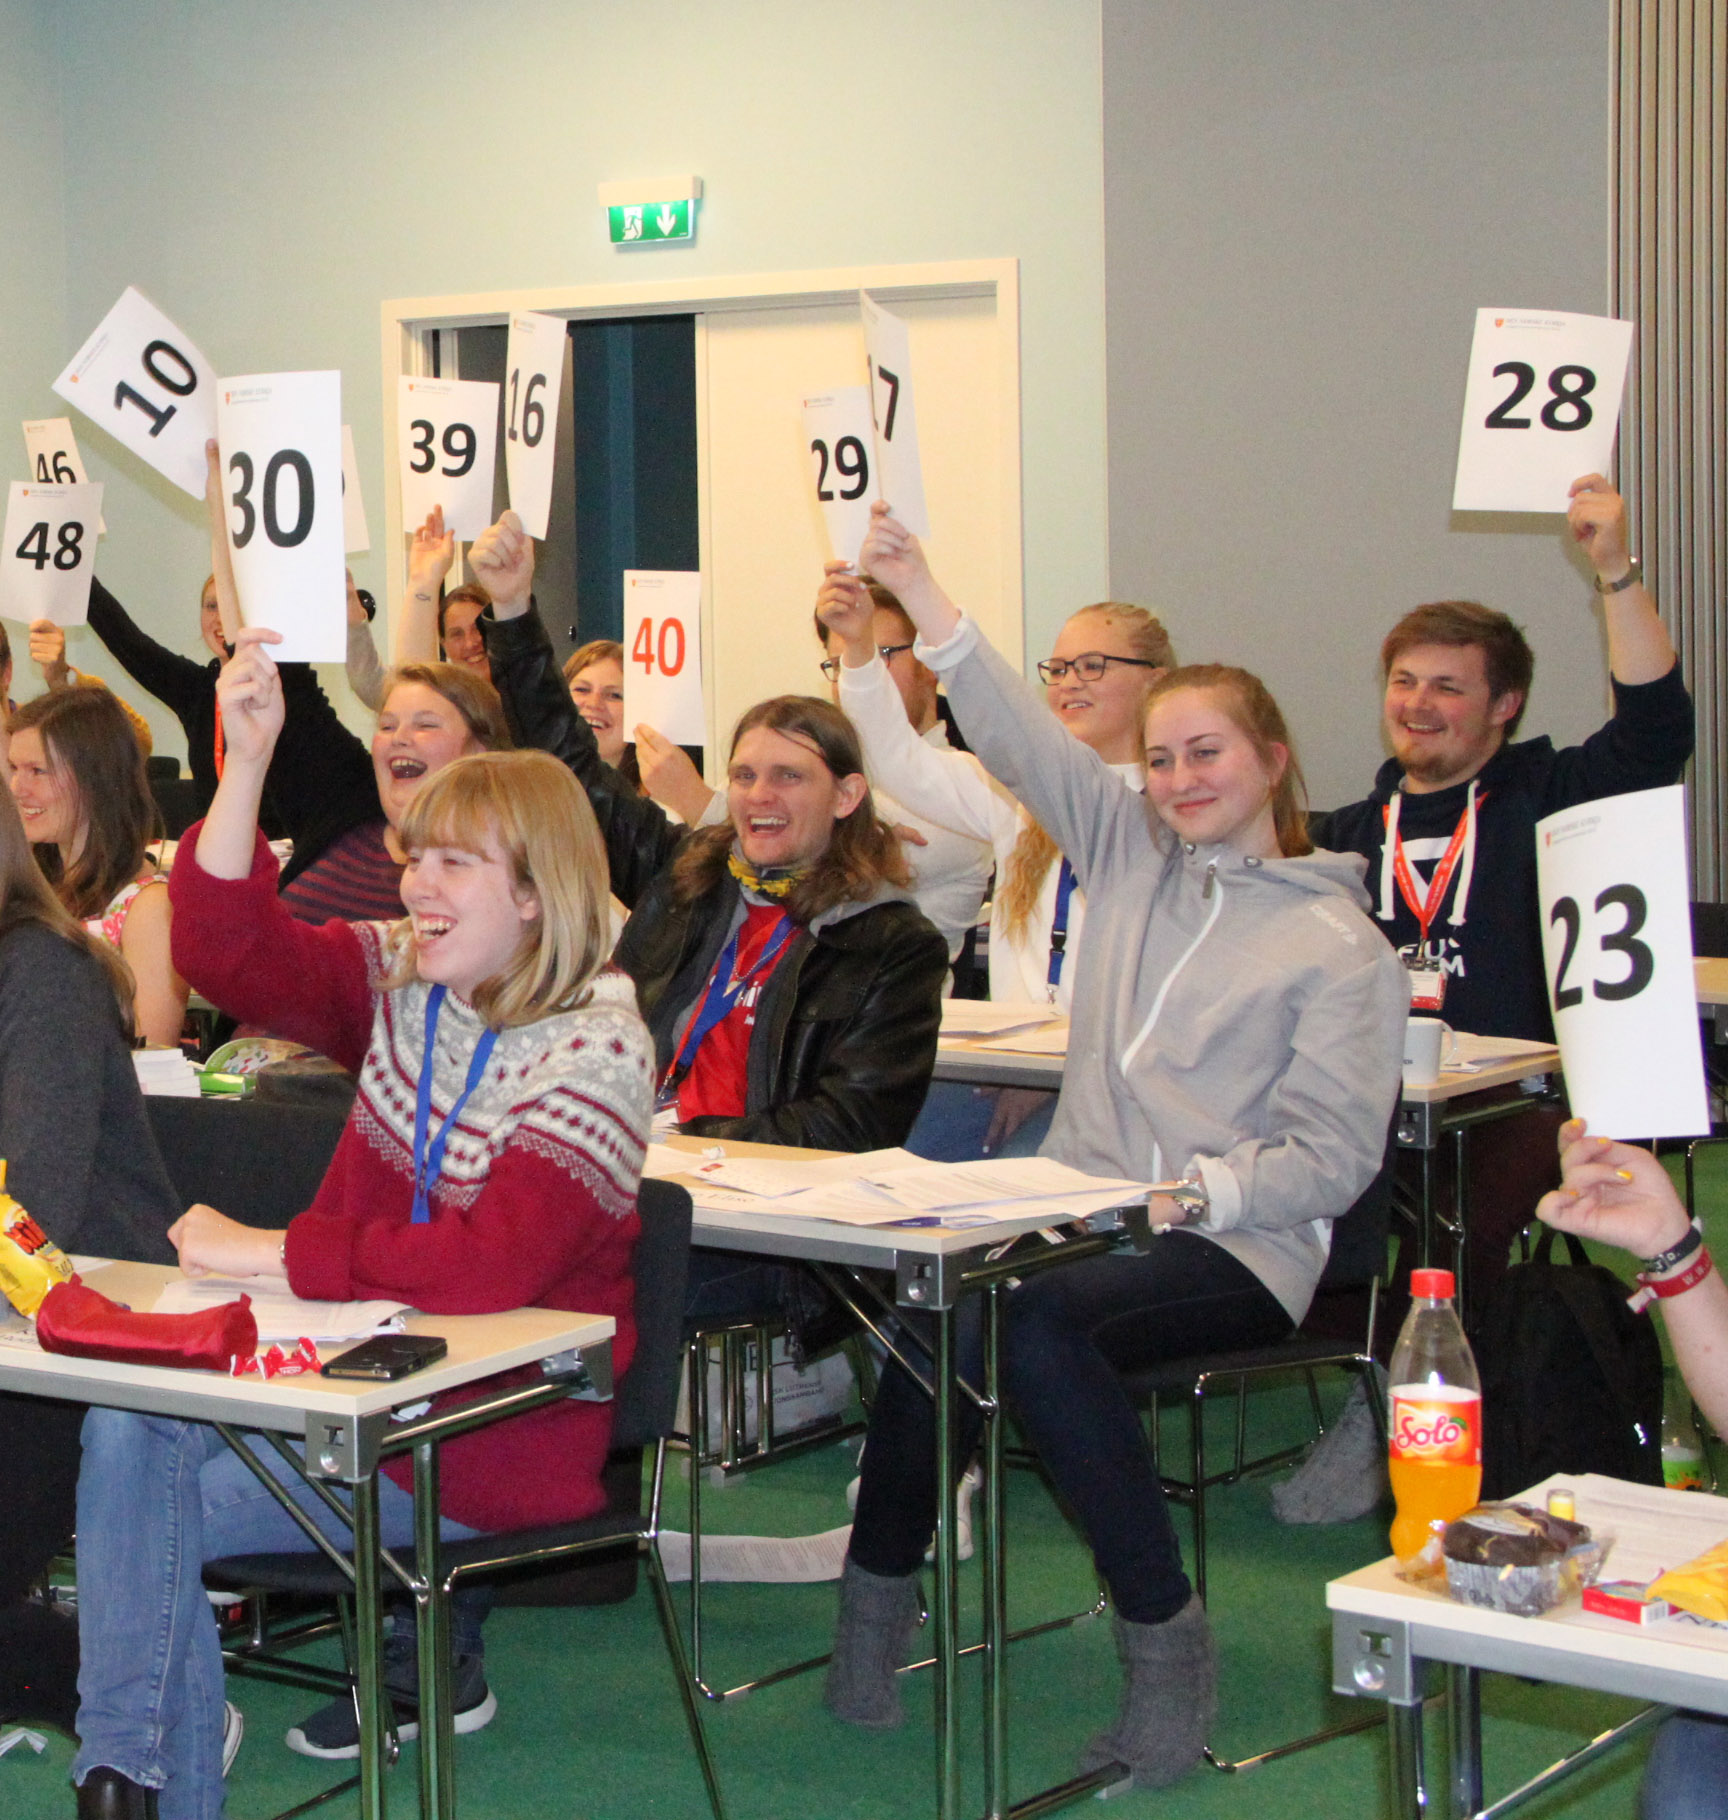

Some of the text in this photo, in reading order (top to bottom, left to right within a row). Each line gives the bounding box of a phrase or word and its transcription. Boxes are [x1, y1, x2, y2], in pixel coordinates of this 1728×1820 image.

[114, 340, 199, 438] 10
[507, 367, 547, 448] 16
[1484, 361, 1597, 432] 28
[36, 449, 78, 484] 46
[409, 419, 478, 478] 39
[811, 435, 870, 502] 29
[229, 448, 316, 548] 30
[15, 521, 84, 571] 48
[631, 615, 687, 678] 40
[1549, 882, 1655, 1012] 23
[1396, 1415, 1460, 1449] Solo
